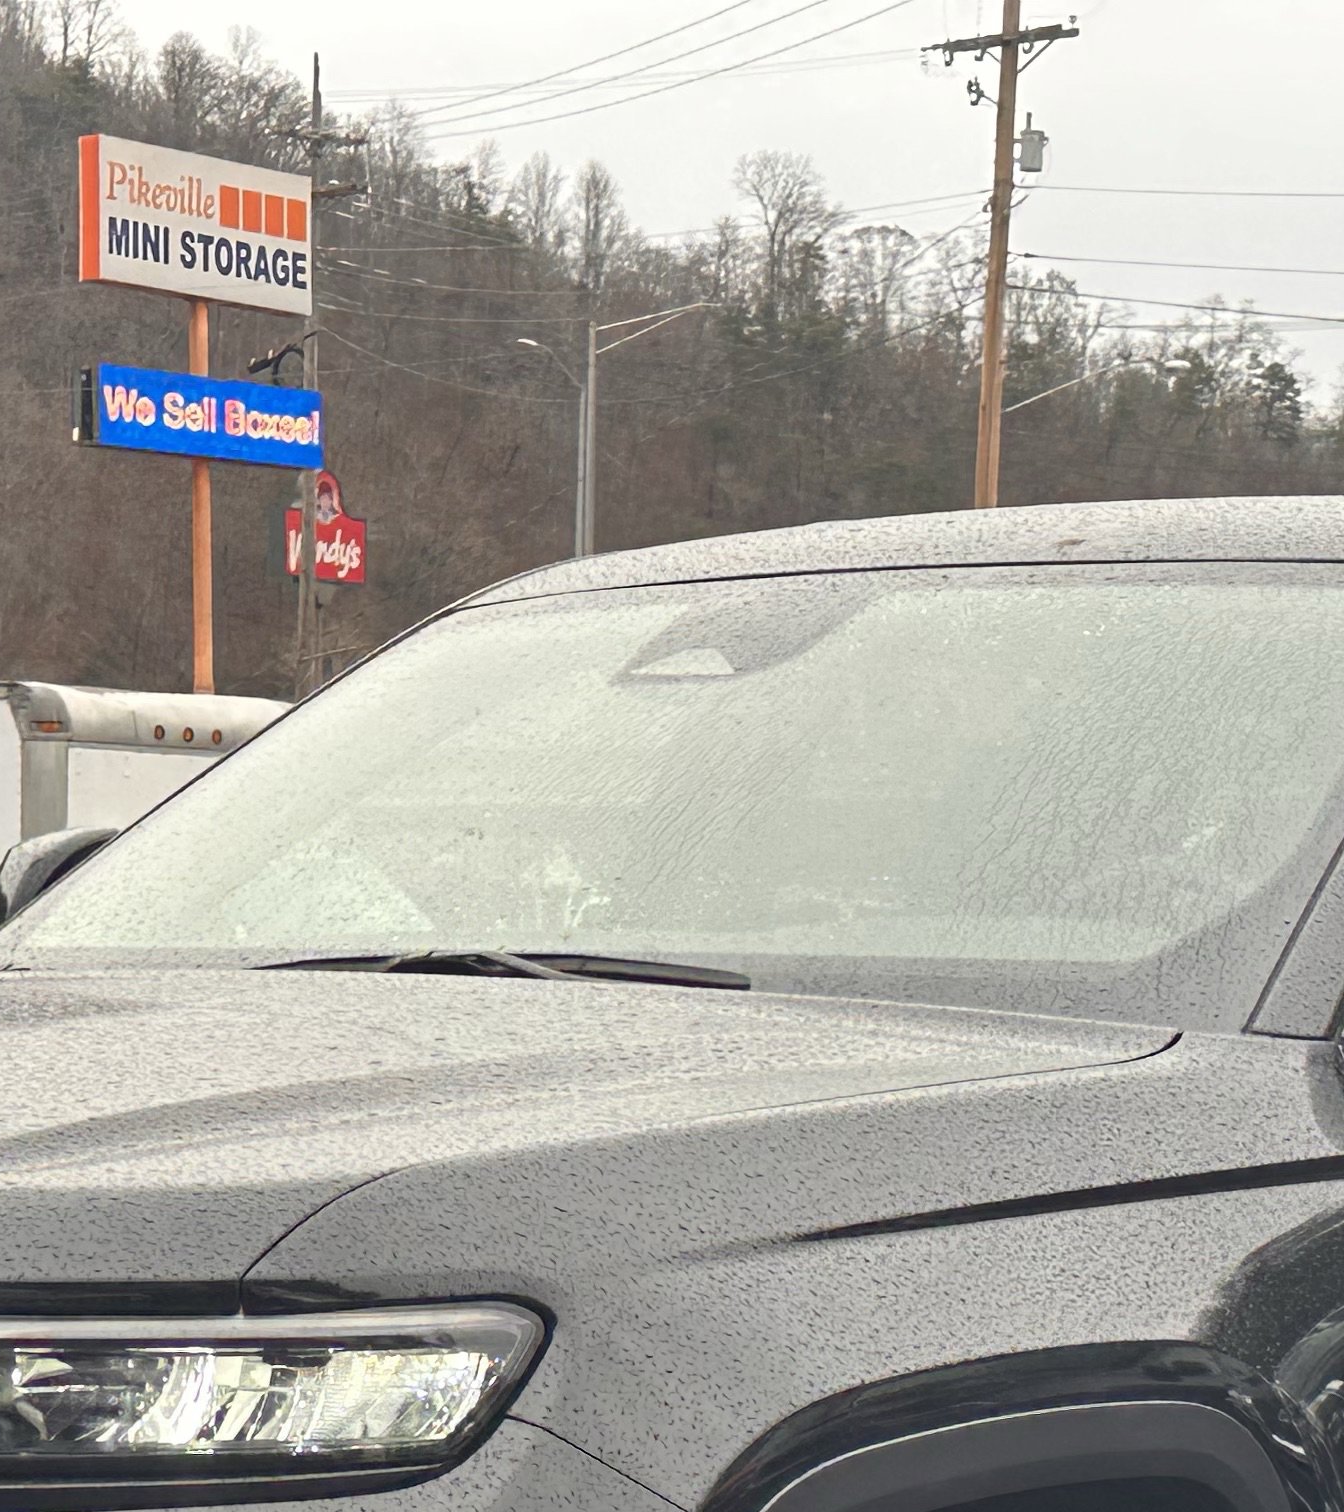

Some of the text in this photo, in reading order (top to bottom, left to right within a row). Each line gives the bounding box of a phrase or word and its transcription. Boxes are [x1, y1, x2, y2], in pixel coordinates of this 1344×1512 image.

[105, 160, 216, 219] Pikeville
[108, 216, 307, 290] MINI STORAGE
[162, 392, 217, 434] Sell
